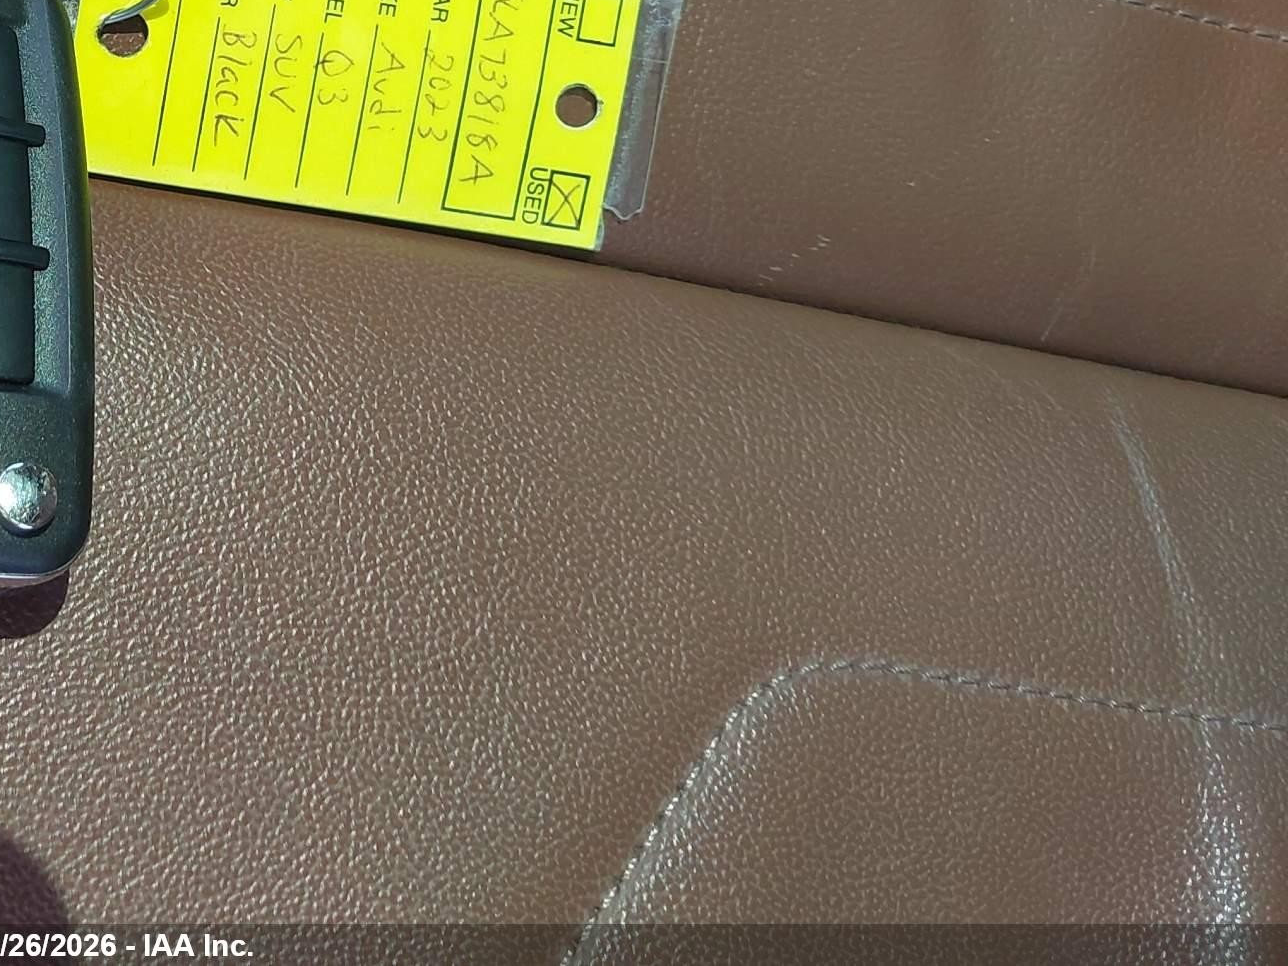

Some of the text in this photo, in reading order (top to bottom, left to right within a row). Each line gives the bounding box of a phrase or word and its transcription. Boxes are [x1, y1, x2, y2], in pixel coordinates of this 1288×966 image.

[269, 33, 303, 114] SUV
[313, 49, 355, 106] Q3
[368, 42, 406, 131] Audi
[417, 46, 454, 142] 2023
[521, 166, 549, 225] USED
